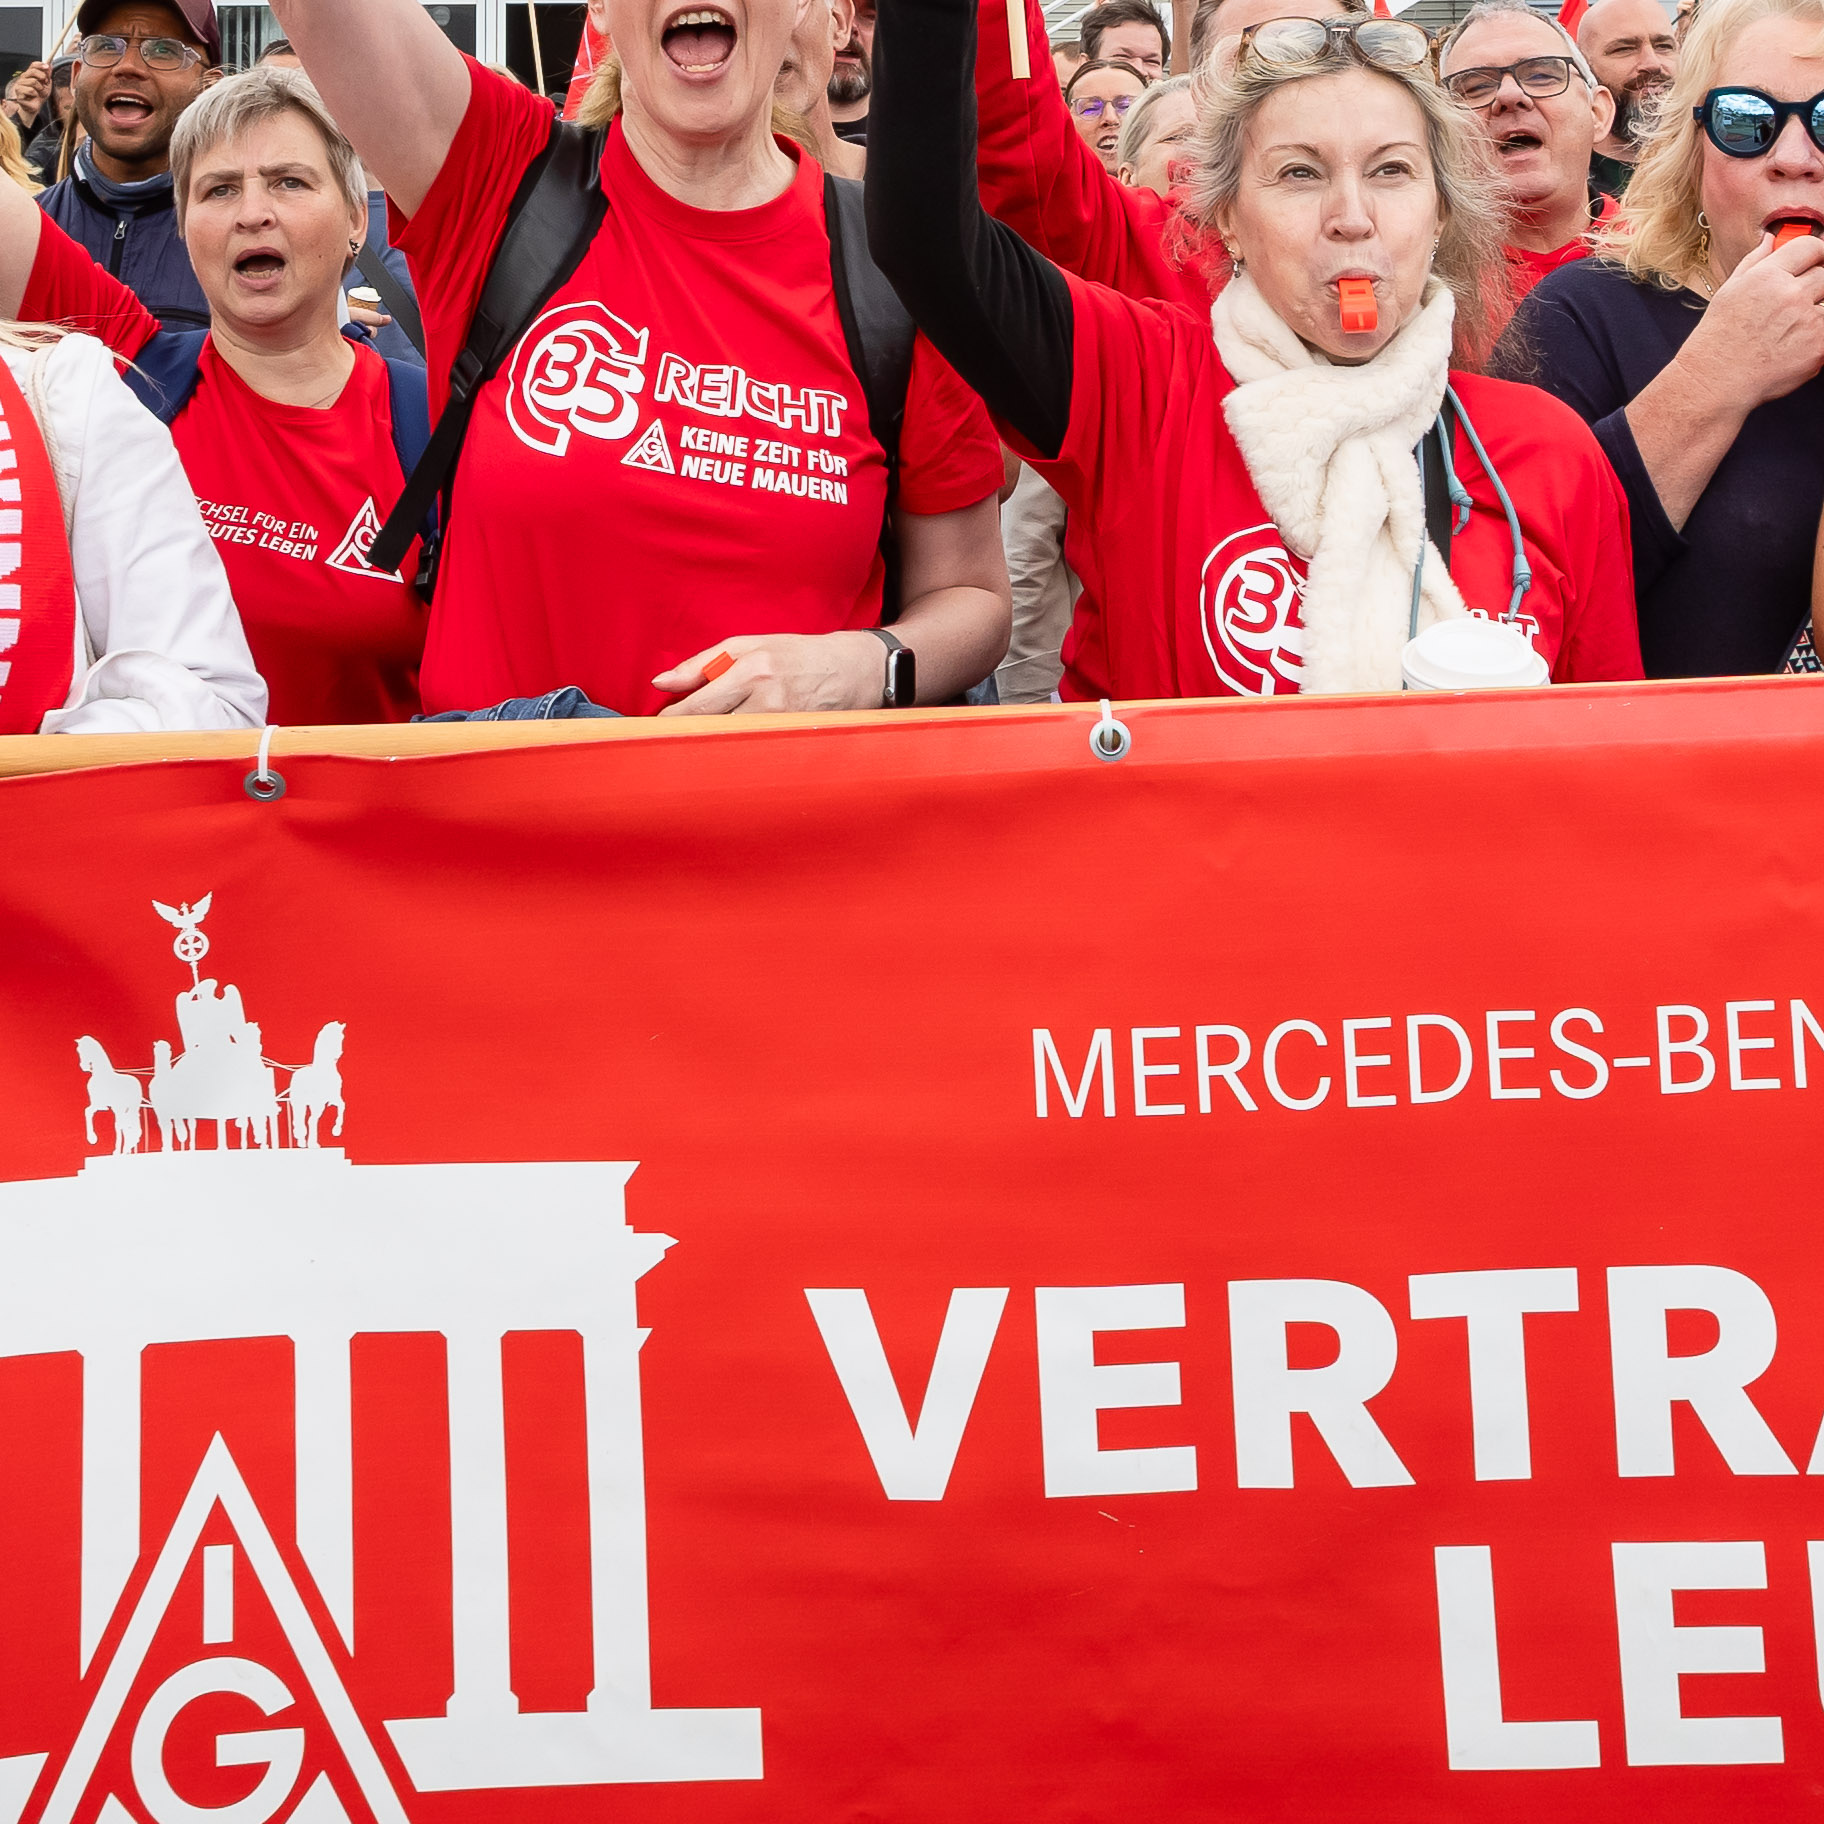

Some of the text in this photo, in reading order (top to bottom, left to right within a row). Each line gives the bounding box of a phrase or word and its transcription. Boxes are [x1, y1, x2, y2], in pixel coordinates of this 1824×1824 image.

[529, 331, 849, 439] 35 REICHT
[680, 426, 848, 477] KEINE ZEIT FÜR
[680, 455, 849, 505] NEUE MAUERN
[252, 511, 288, 535] FÜR
[290, 522, 319, 541] EIN
[258, 532, 319, 561] LEBEN
